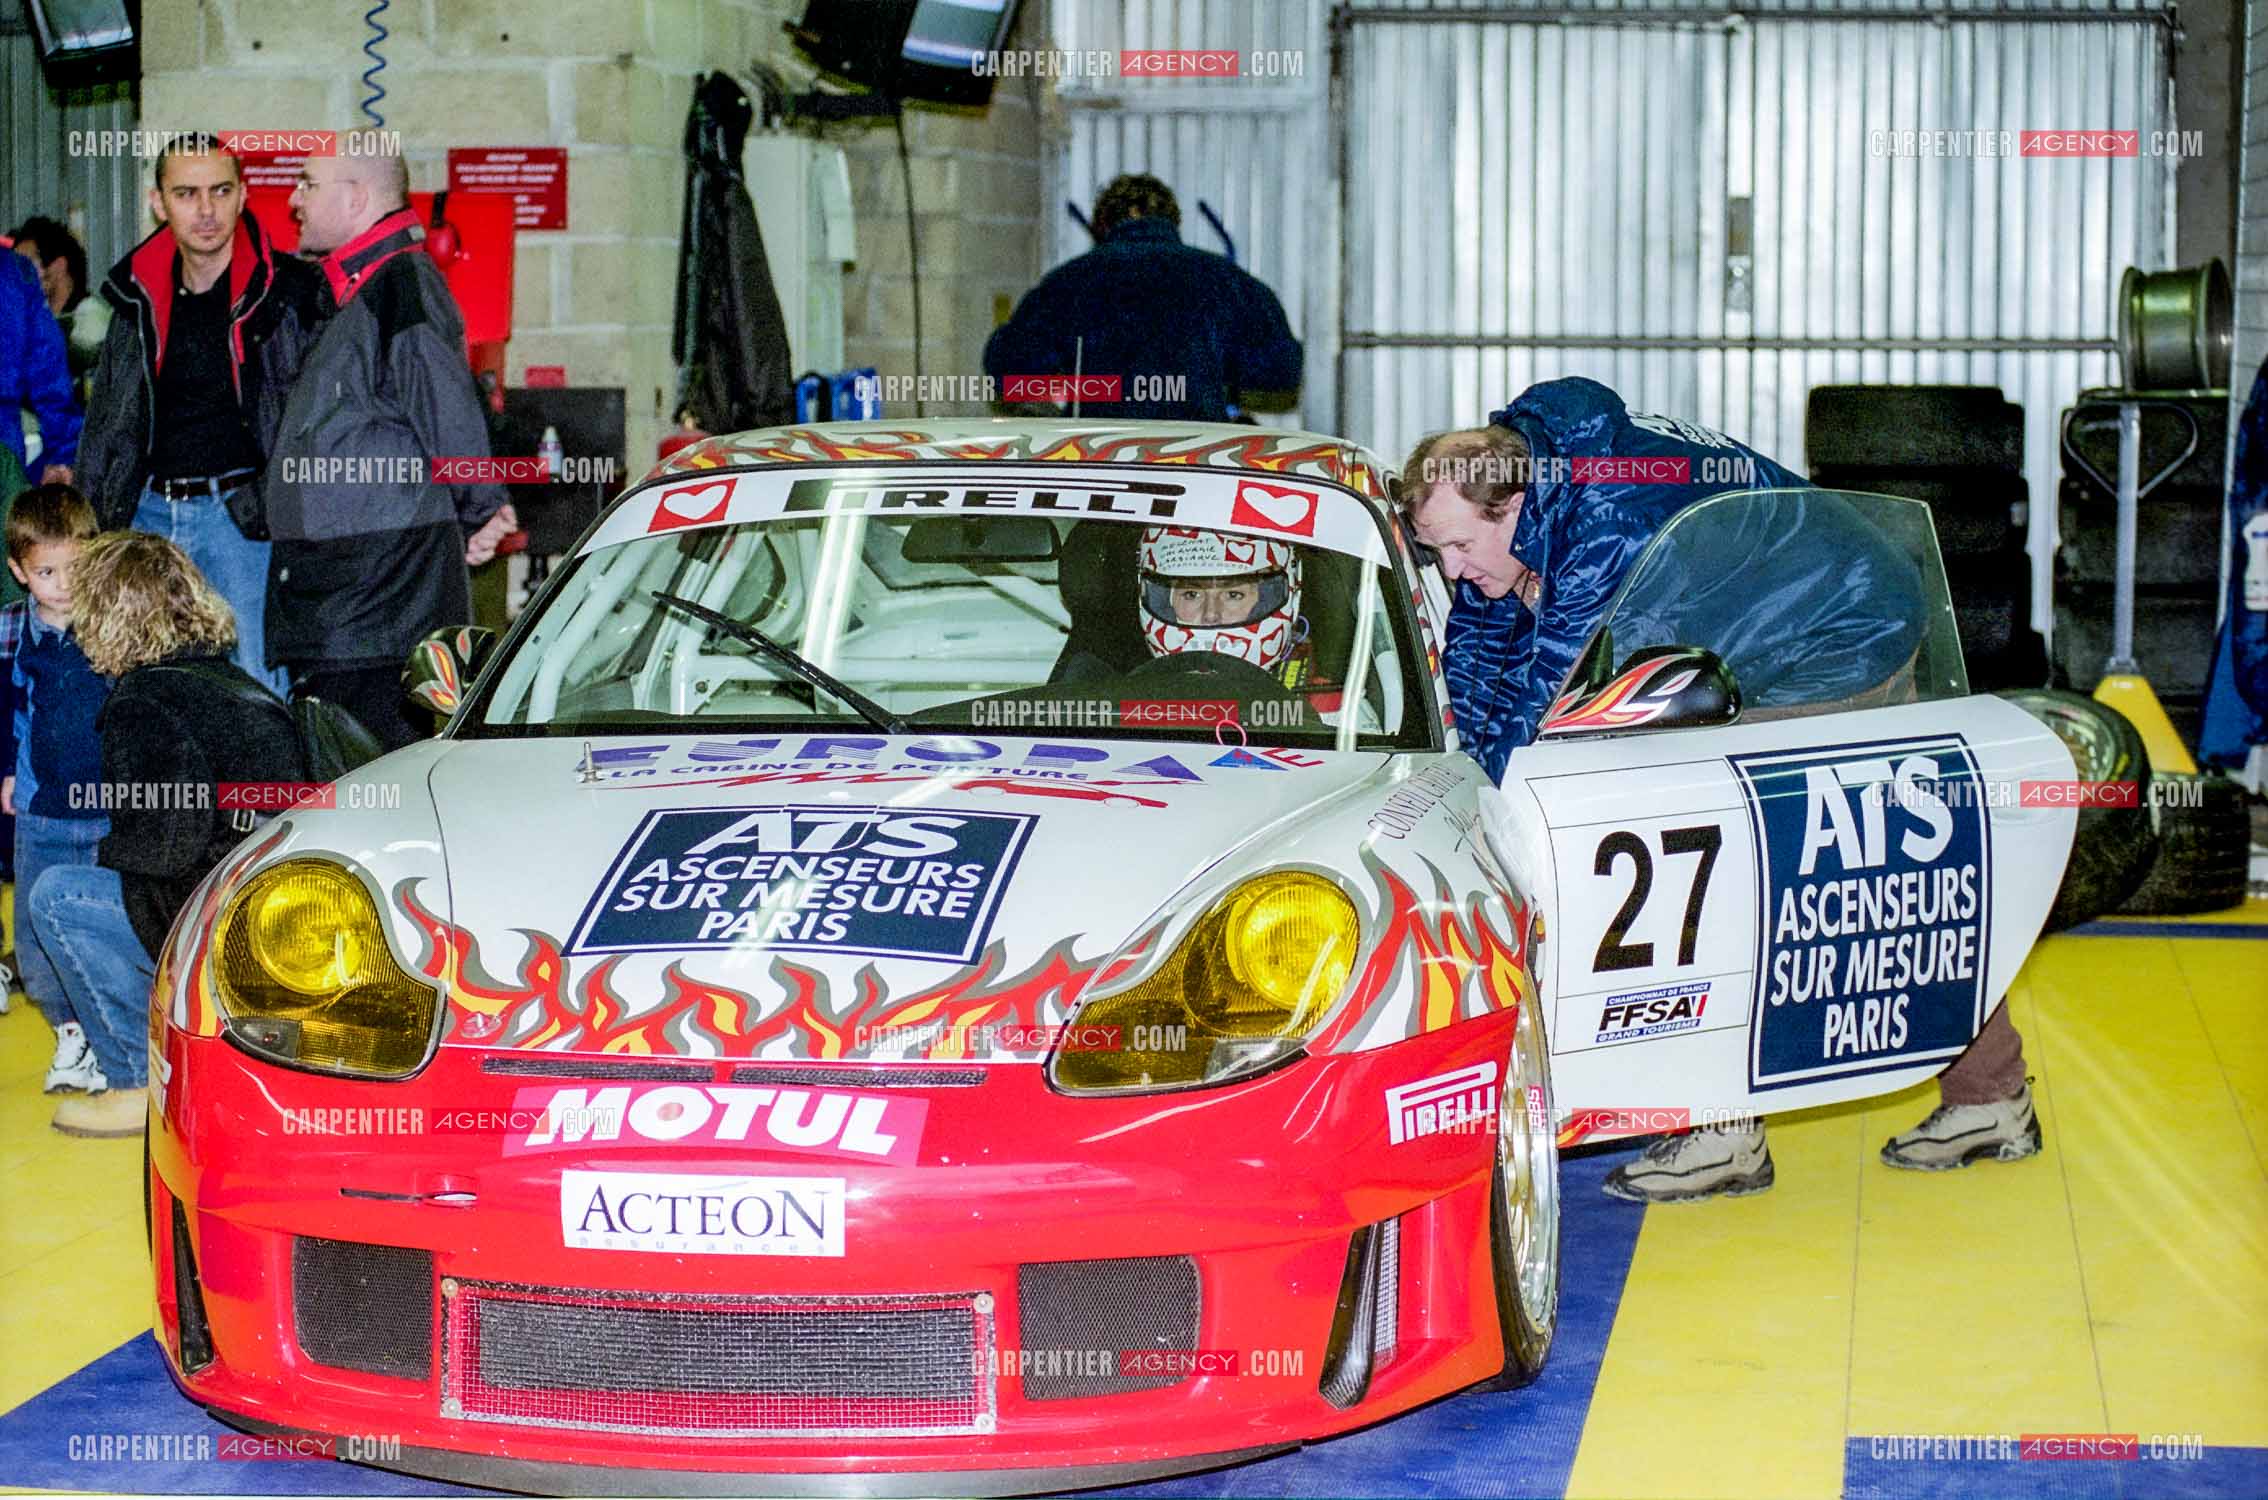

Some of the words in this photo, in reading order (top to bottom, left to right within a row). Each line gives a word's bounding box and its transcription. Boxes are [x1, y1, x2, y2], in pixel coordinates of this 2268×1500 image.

[783, 476, 1186, 517] PIRELLI
[611, 769, 656, 778] LA
[670, 762, 812, 774] CABINE
[824, 762, 880, 771] DE
[684, 811, 969, 858] ATS
[1798, 755, 1954, 876] ATS
[630, 855, 985, 889] ASCENSEURS
[613, 882, 729, 912] SUR
[738, 882, 974, 919] MESURE
[1592, 824, 1722, 973] 27
[1775, 863, 1977, 944] ASCENSEURS
[697, 911, 853, 942] PARIS
[1770, 944, 1838, 1007] SUR
[1843, 926, 1977, 996] MESURE
[1599, 996, 1692, 1031] FFSA
[1608, 989, 1668, 1006] CHAMPIONNAT
[1668, 988, 1678, 997] DE
[1679, 983, 1709, 995] FRANCE
[1598, 1029, 1641, 1042] GRAND
[1643, 1020, 1698, 1036] TOURISME
[1823, 994, 1910, 1059] PARIS
[524, 1086, 899, 1156] MOTUL
[1385, 1061, 1498, 1146] PIRELLI
[577, 1184, 831, 1240] ACTEON
